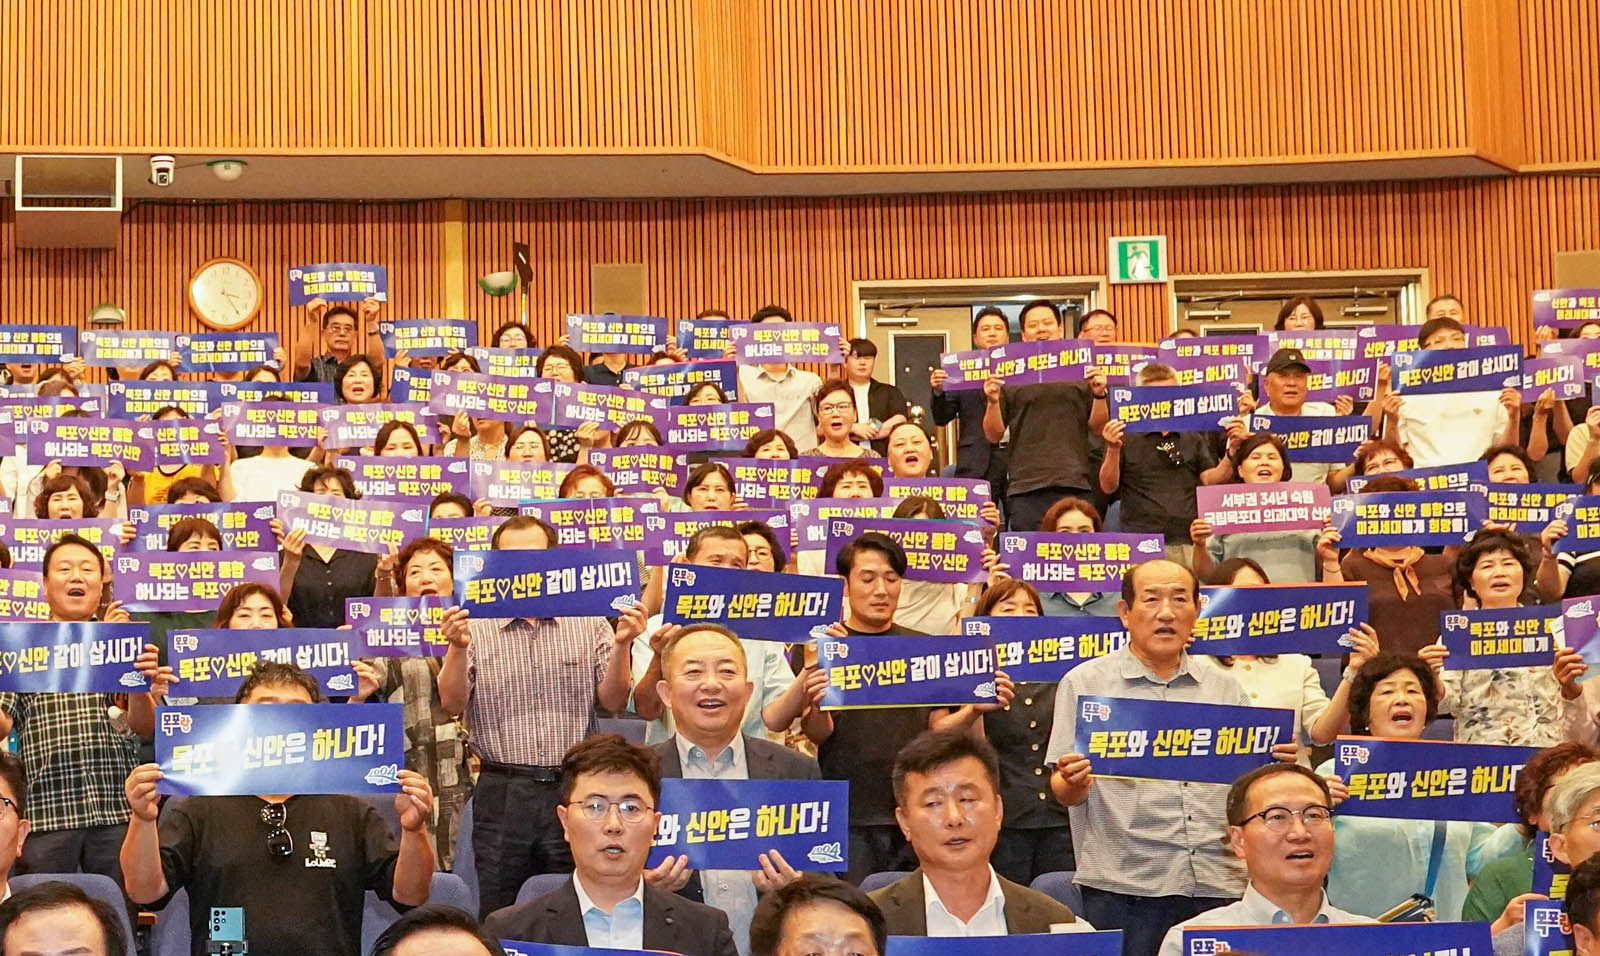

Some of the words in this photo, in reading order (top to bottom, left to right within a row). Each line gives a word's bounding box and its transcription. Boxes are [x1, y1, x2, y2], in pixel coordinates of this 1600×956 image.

[1221, 491, 1258, 508] 서부권
[1260, 490, 1288, 506] 34년
[1394, 504, 1417, 518] 신안
[546, 568, 576, 595] 같이
[580, 562, 632, 590] 삽시다!
[676, 595, 725, 619] 목포와
[728, 593, 772, 618] 신안은
[774, 592, 829, 617] 하나다!
[1191, 616, 1245, 641] 목포와
[1248, 608, 1296, 636] 신안은
[1300, 600, 1355, 629] 하나다!
[52, 644, 86, 668] 같이
[88, 637, 142, 664] 삽시다!
[296, 642, 349, 669] 삽시다!
[910, 655, 940, 681] 같이
[944, 649, 994, 677] 삽시다!
[1027, 636, 1075, 663] 신안은
[244, 731, 306, 769] 신안은
[312, 724, 385, 763] 하나다!
[1088, 730, 1149, 758] 목포와
[1153, 728, 1212, 757] 신안은
[1215, 726, 1281, 755] 하나다!
[1348, 772, 1407, 800] 목포와
[1411, 768, 1467, 798] 신안은
[685, 808, 750, 844] 신안은
[756, 801, 830, 837] 하나다!
